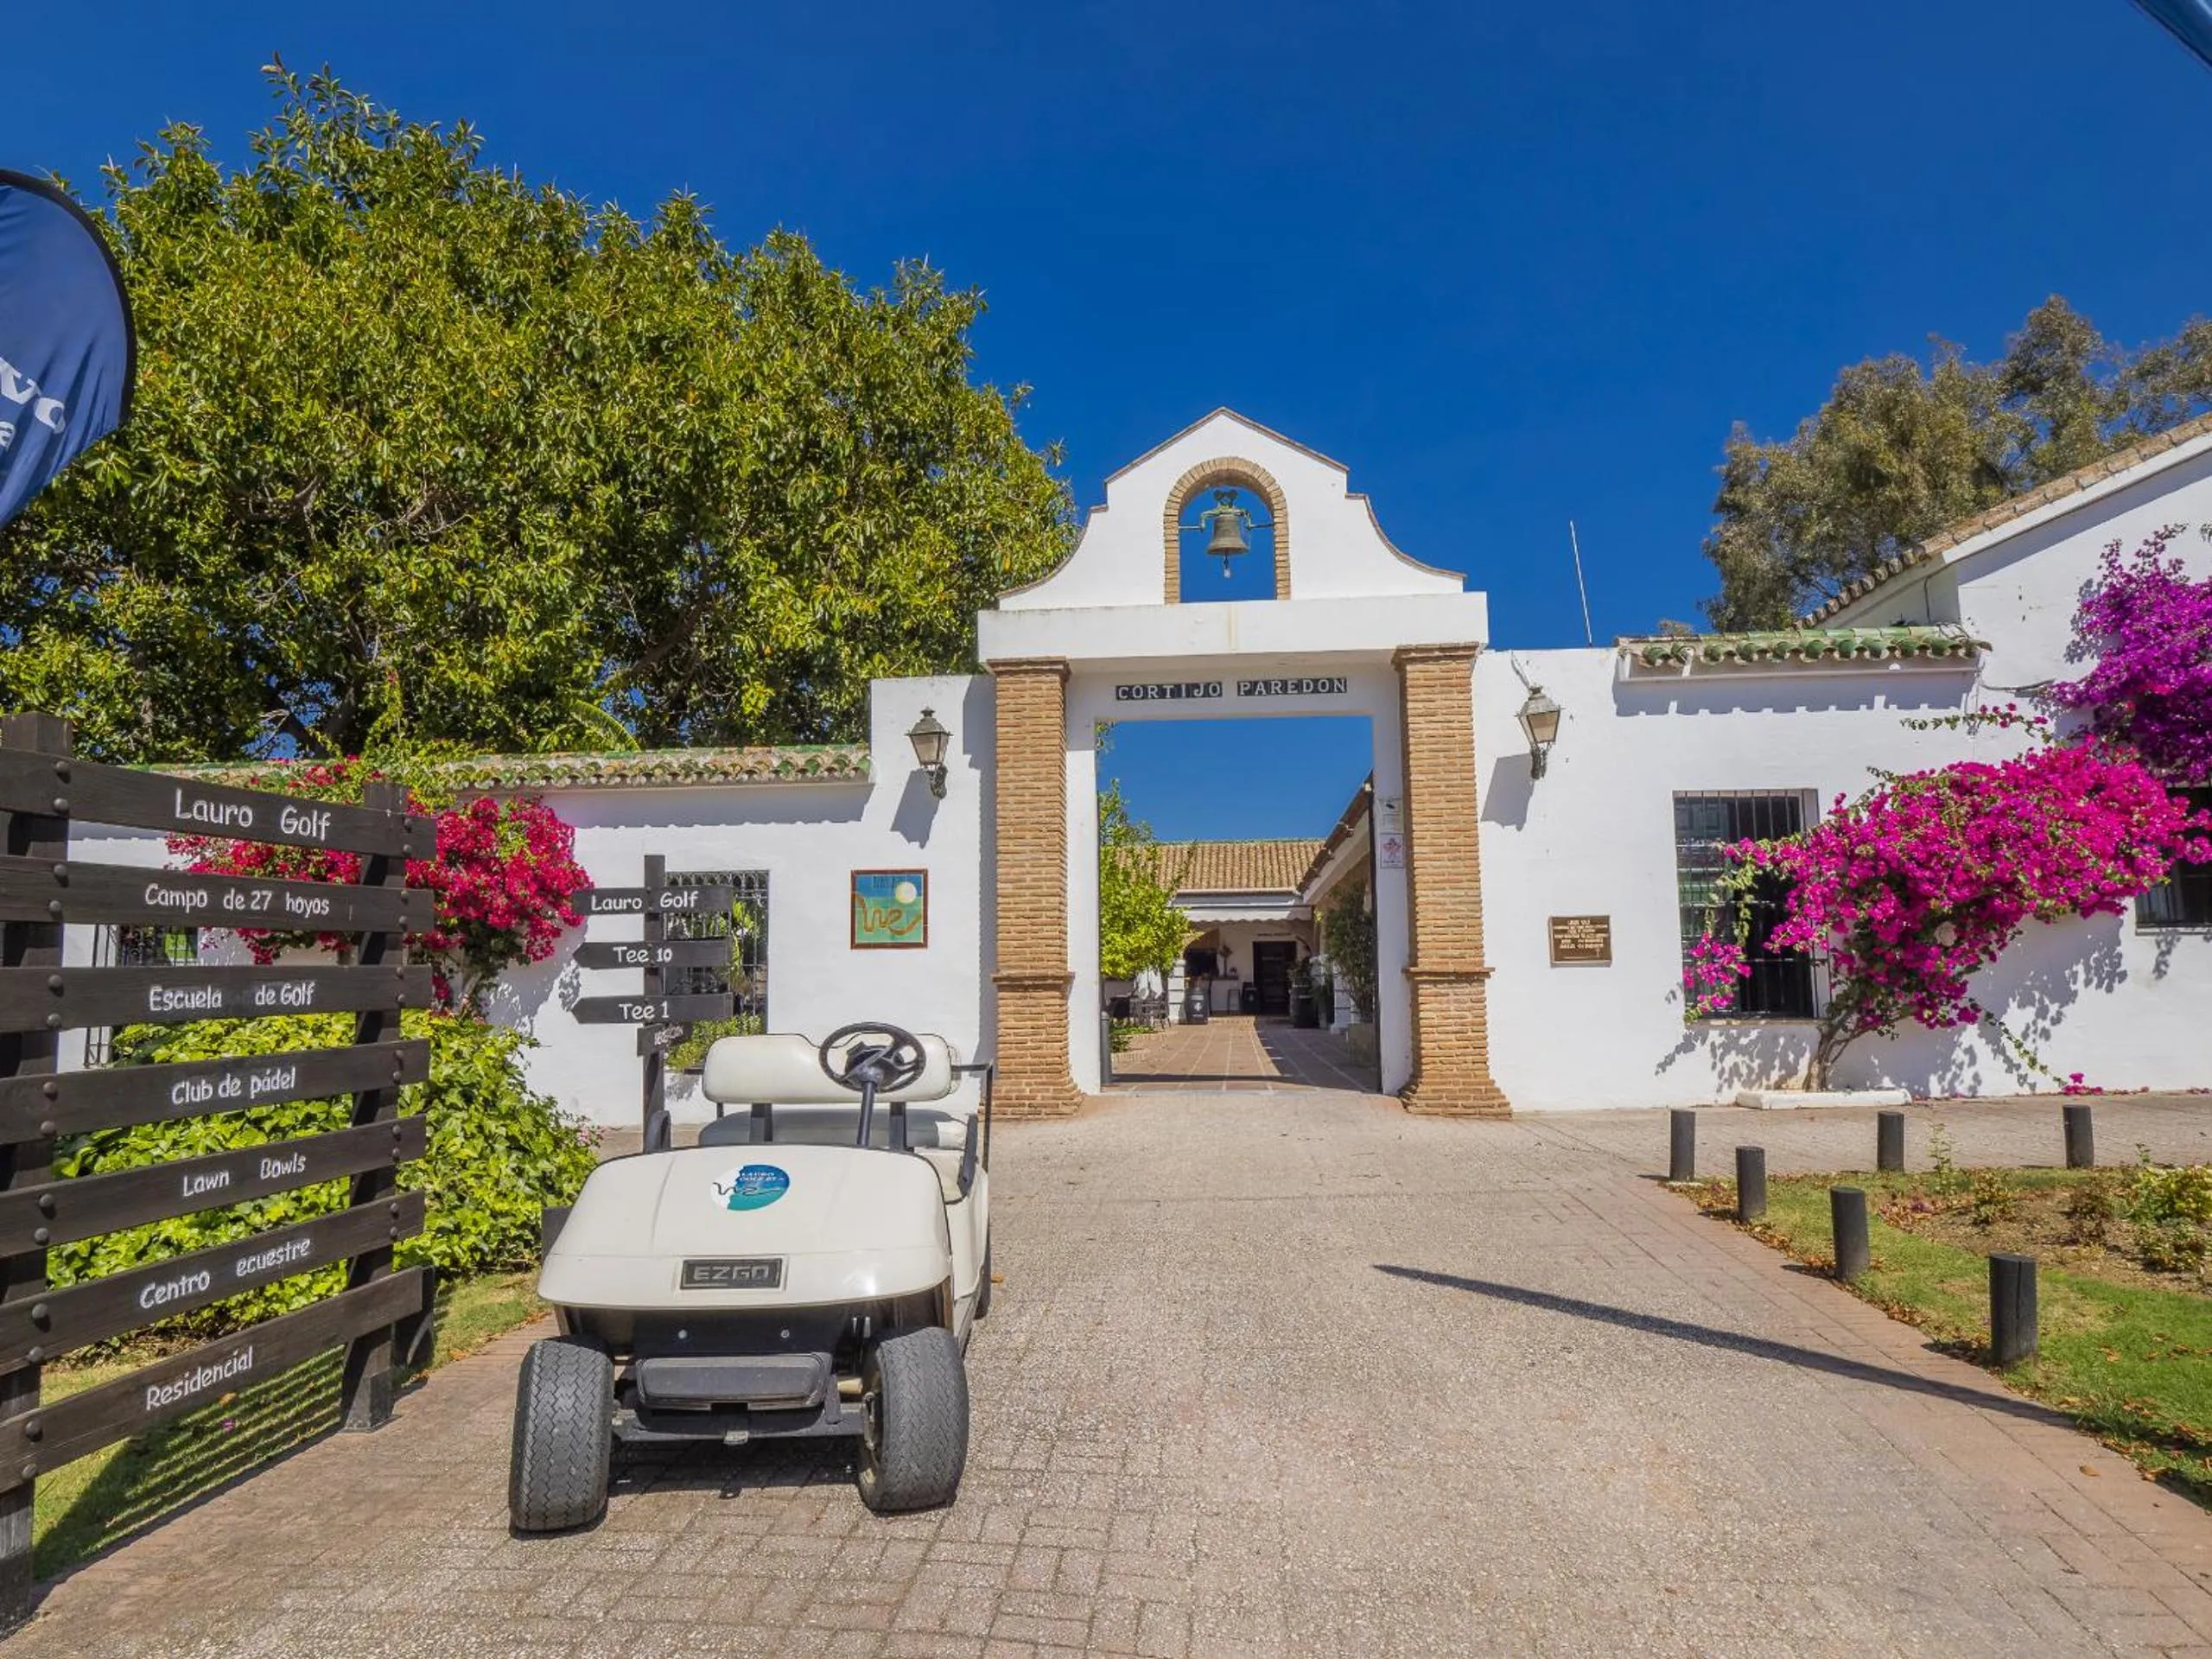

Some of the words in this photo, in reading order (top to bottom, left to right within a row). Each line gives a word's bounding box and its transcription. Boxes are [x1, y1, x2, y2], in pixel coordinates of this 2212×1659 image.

[1117, 683, 1221, 699] CORTIJO
[1239, 678, 1347, 696] PAREDON
[175, 789, 253, 828] Lauro
[280, 805, 332, 841] Golf
[145, 882, 208, 912] Campo
[223, 889, 245, 911] de
[251, 890, 273, 911] 27
[285, 893, 330, 919] hoyos
[591, 895, 642, 911] Lauro
[660, 891, 699, 908] Golf
[613, 946, 649, 963] Tee
[657, 949, 672, 963] 10
[149, 985, 222, 1012] Escuela
[255, 985, 278, 1006] de
[280, 982, 316, 1007] Golf
[619, 1003, 655, 1020] Tee
[662, 1001, 670, 1018] 1
[172, 1079, 213, 1105] Club
[218, 1073, 242, 1098] de
[250, 1066, 296, 1100] pádel
[183, 1169, 230, 1198] Lawn
[260, 1152, 307, 1180] Bowls
[139, 1270, 211, 1309] Centro
[236, 1238, 311, 1278] ecuestre
[694, 1266, 770, 1281] EZGO
[146, 1344, 253, 1412] Residencial
